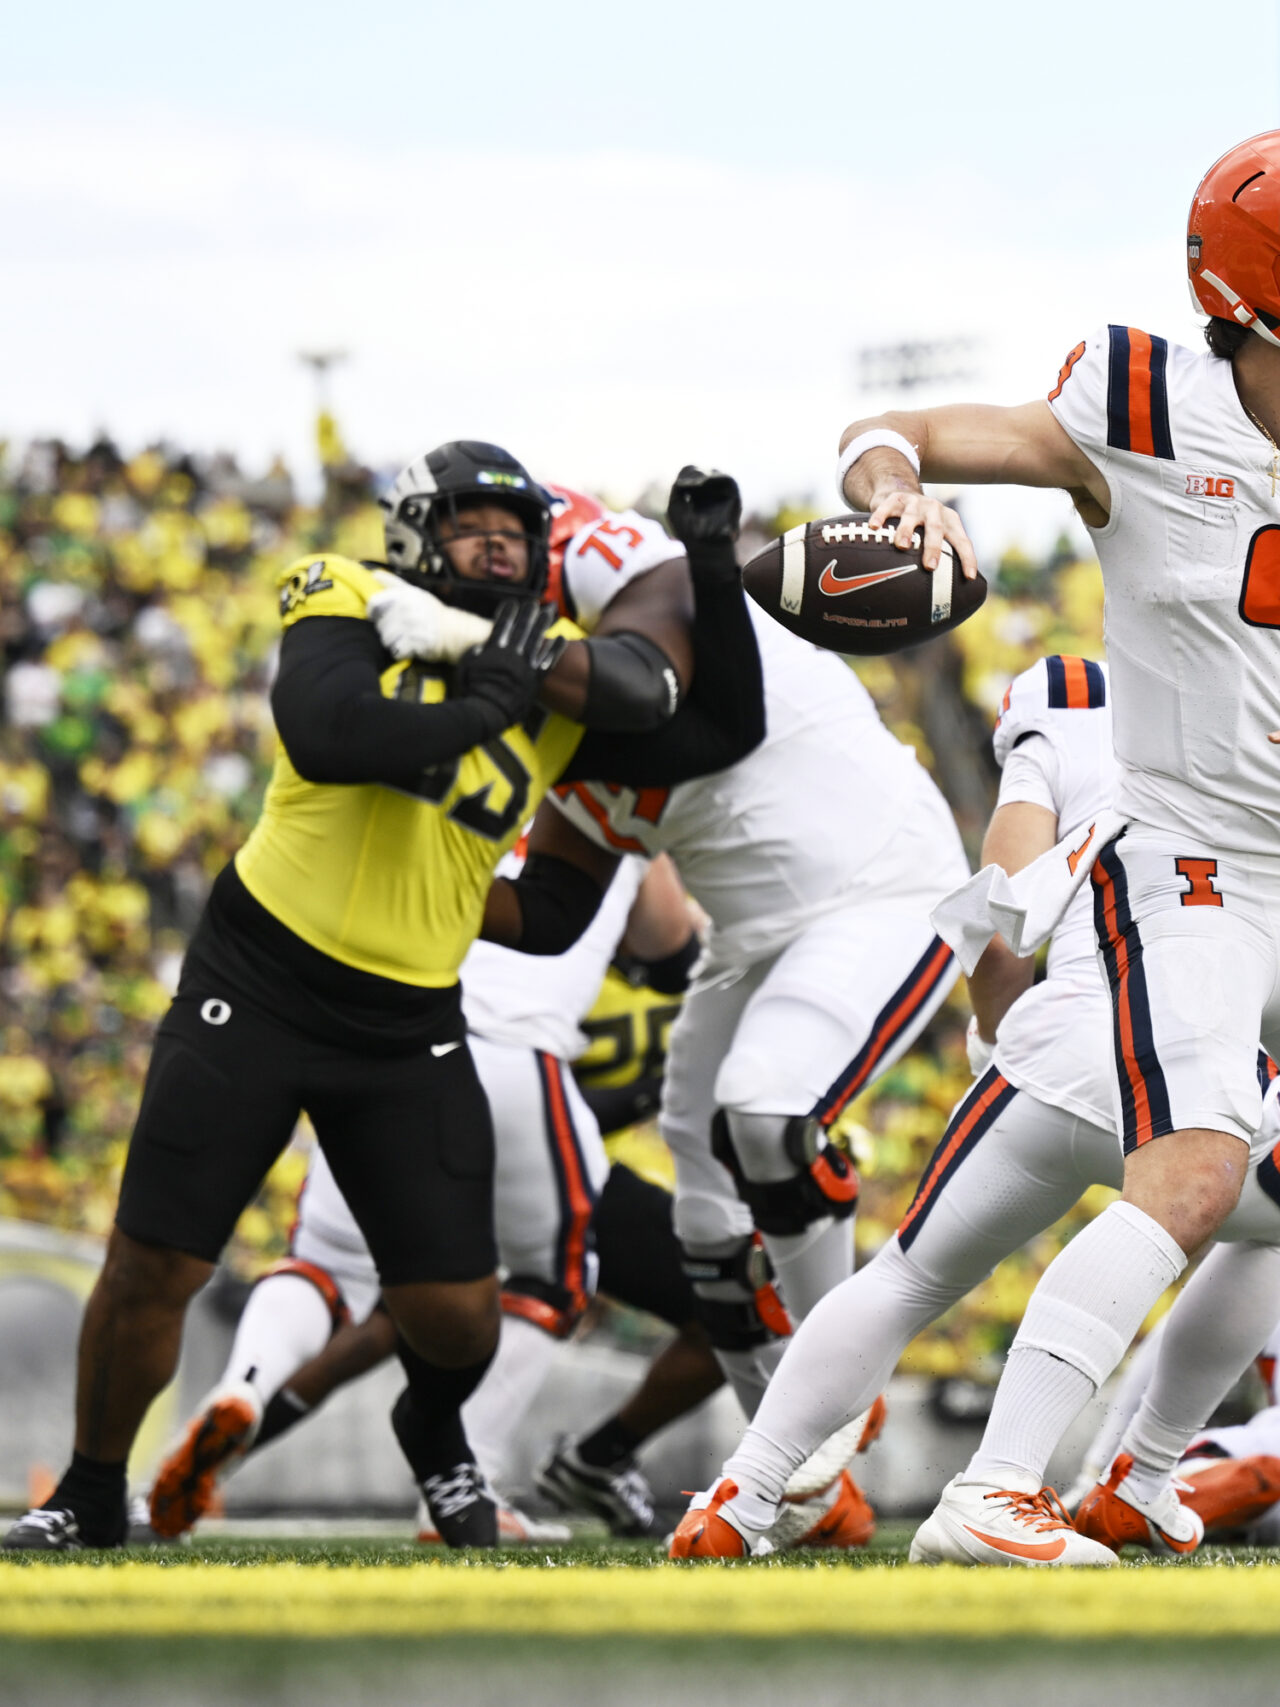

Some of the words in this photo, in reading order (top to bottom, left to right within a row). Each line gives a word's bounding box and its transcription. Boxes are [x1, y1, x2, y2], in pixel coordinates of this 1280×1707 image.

[577, 520, 644, 572] 75
[1174, 856, 1224, 908] I
[200, 998, 232, 1026] O
